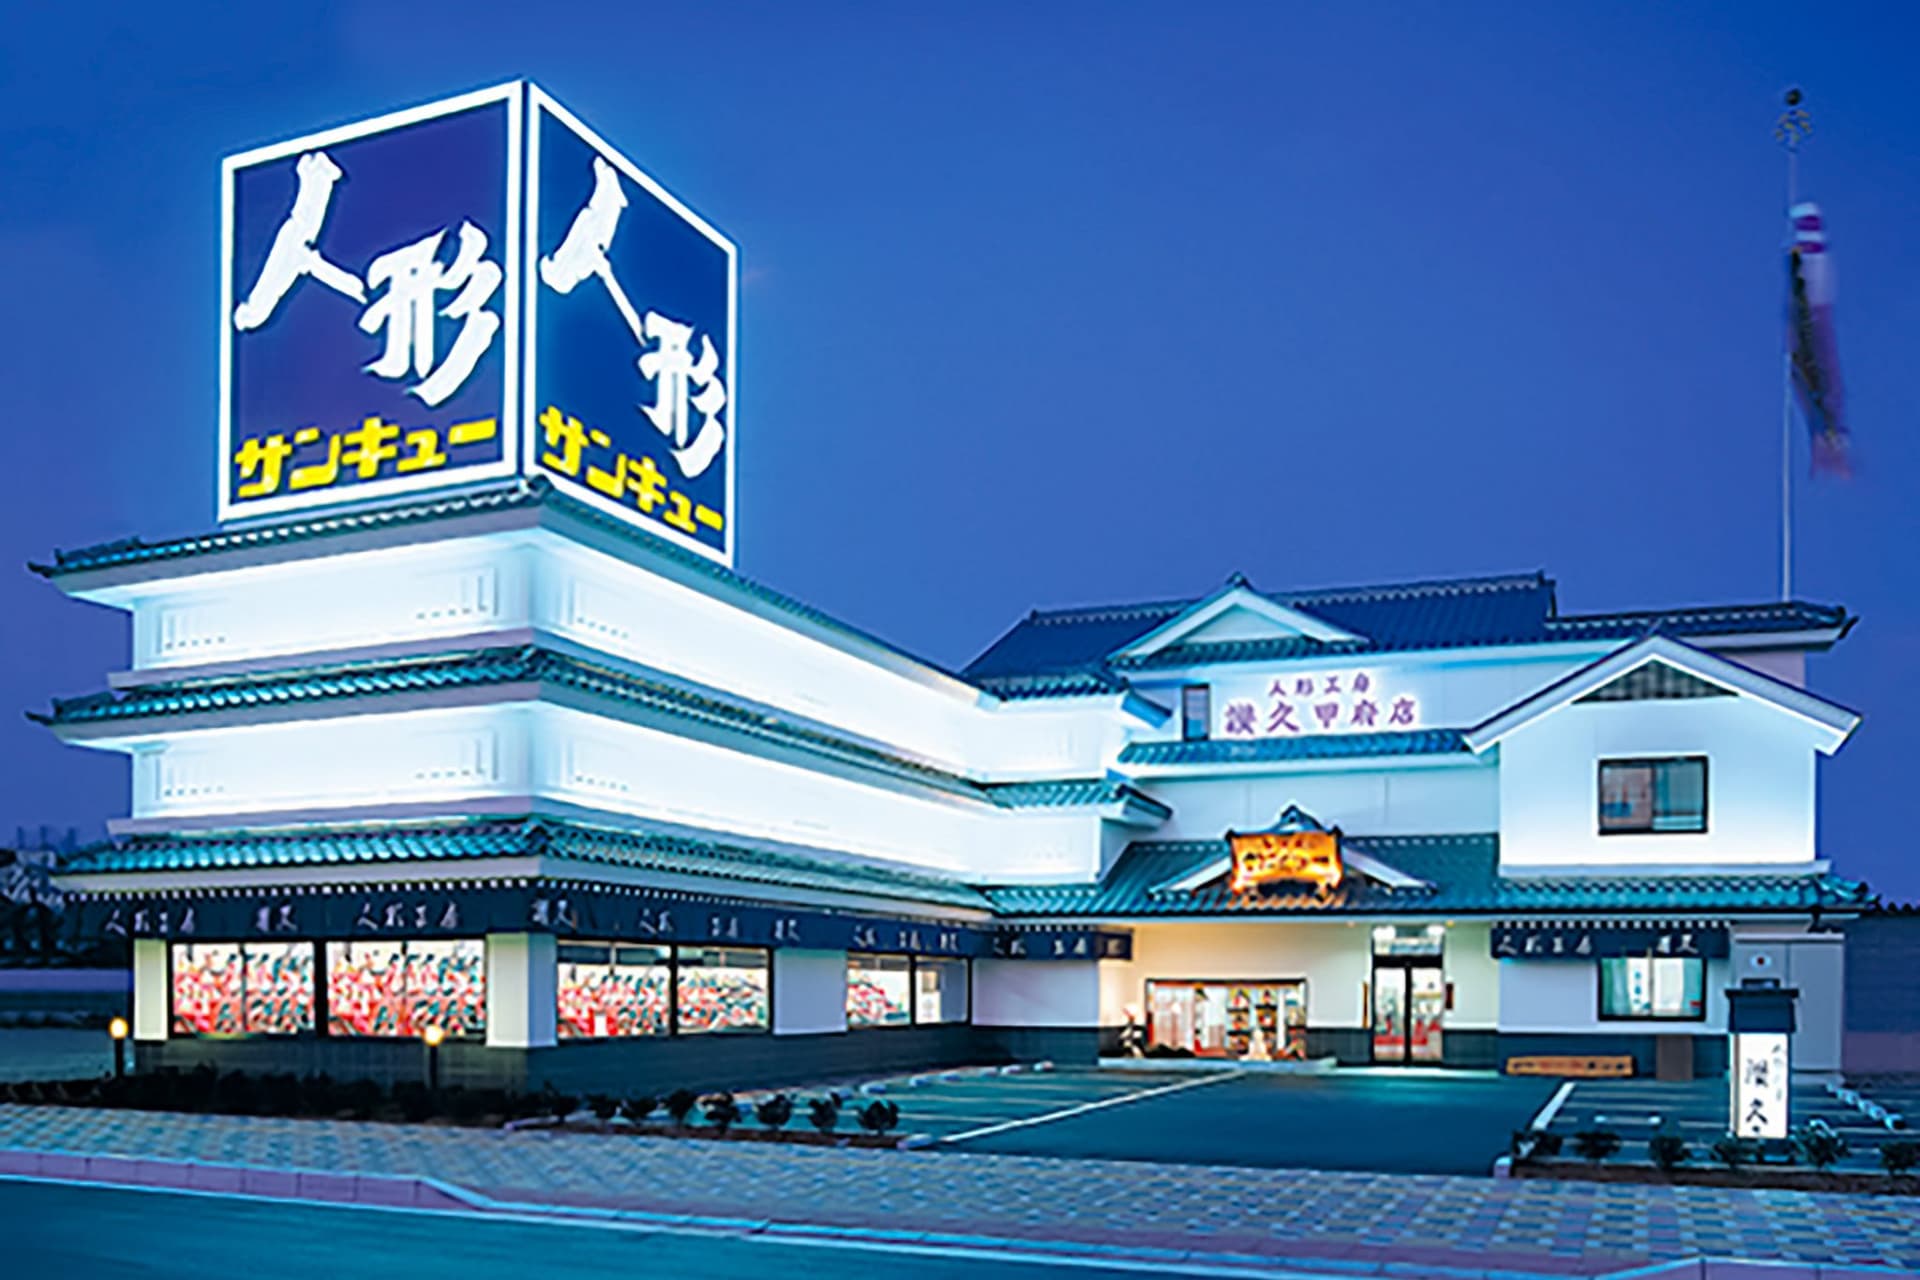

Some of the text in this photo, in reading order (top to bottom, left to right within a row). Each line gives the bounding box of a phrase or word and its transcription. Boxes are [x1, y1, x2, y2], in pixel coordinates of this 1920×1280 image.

[234, 151, 502, 406] 人形
[540, 156, 726, 478] 人形
[234, 417, 497, 498] サンキュー
[539, 405, 724, 533] サンキュー
